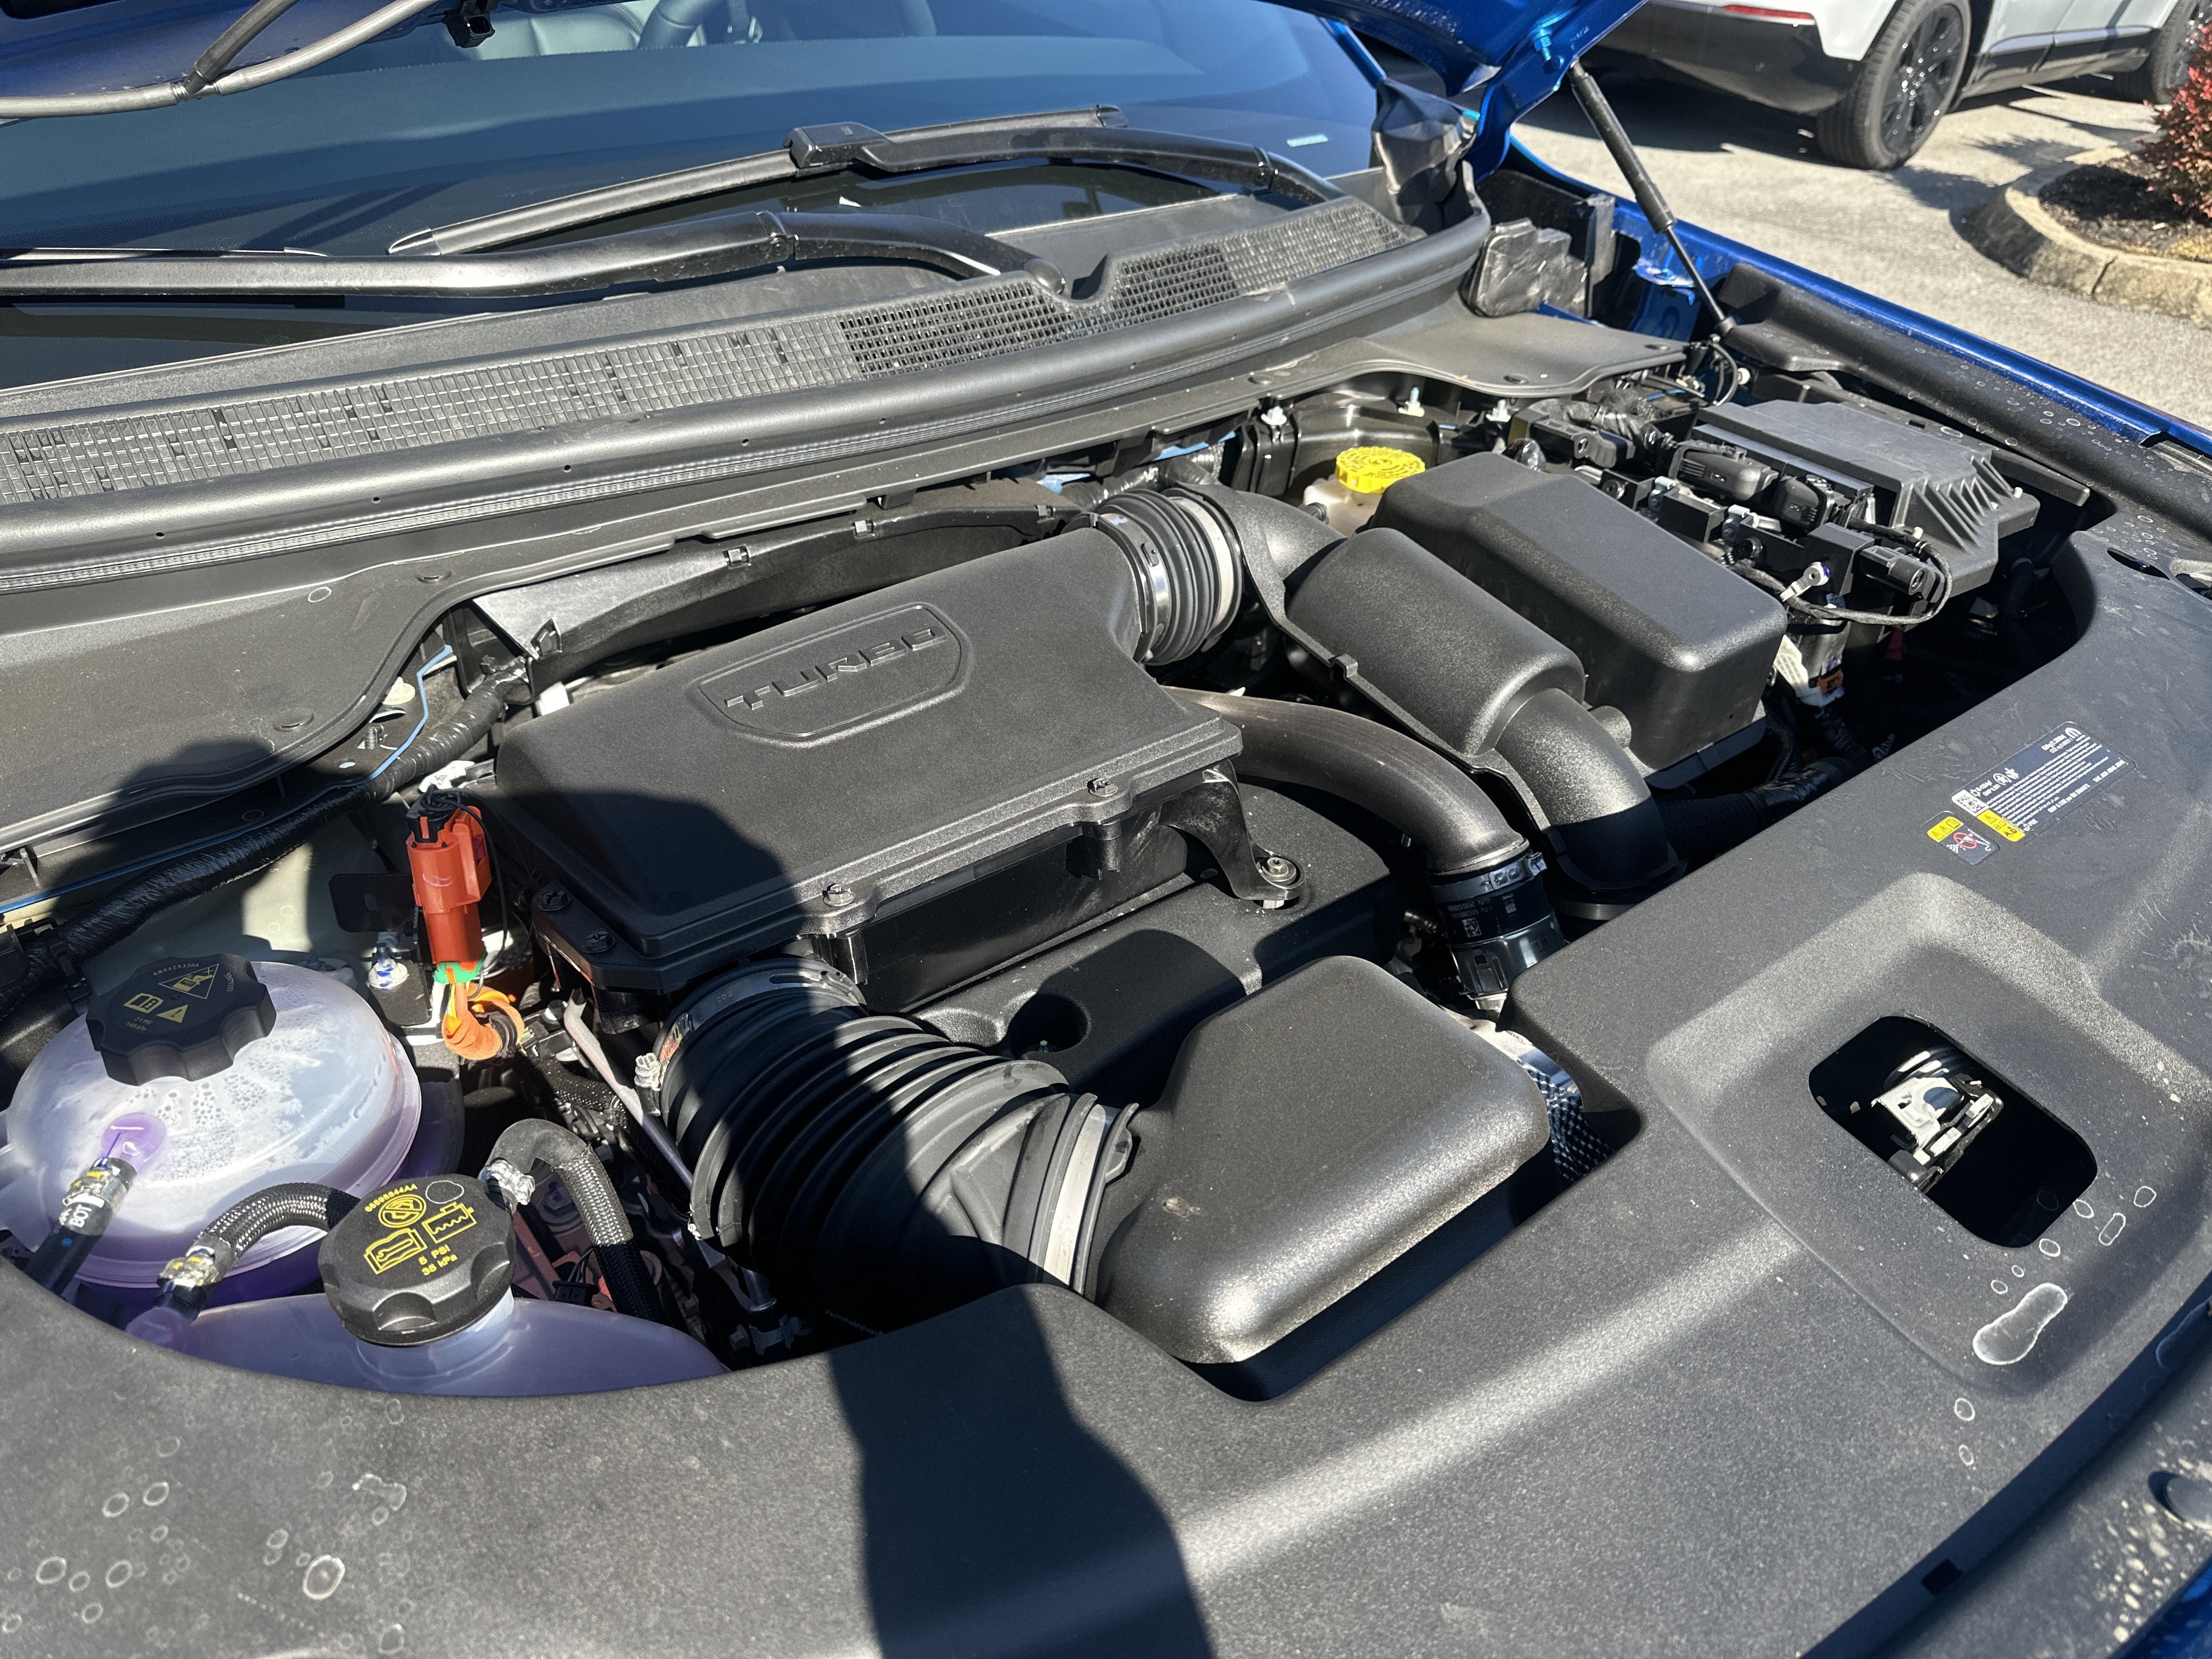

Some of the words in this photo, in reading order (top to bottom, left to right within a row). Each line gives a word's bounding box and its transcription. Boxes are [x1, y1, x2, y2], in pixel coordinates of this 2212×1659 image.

[724, 628, 947, 710] TURBO
[69, 1204, 92, 1228] BOT
[431, 1244, 452, 1260] PSI
[437, 1254, 458, 1268] kPa
